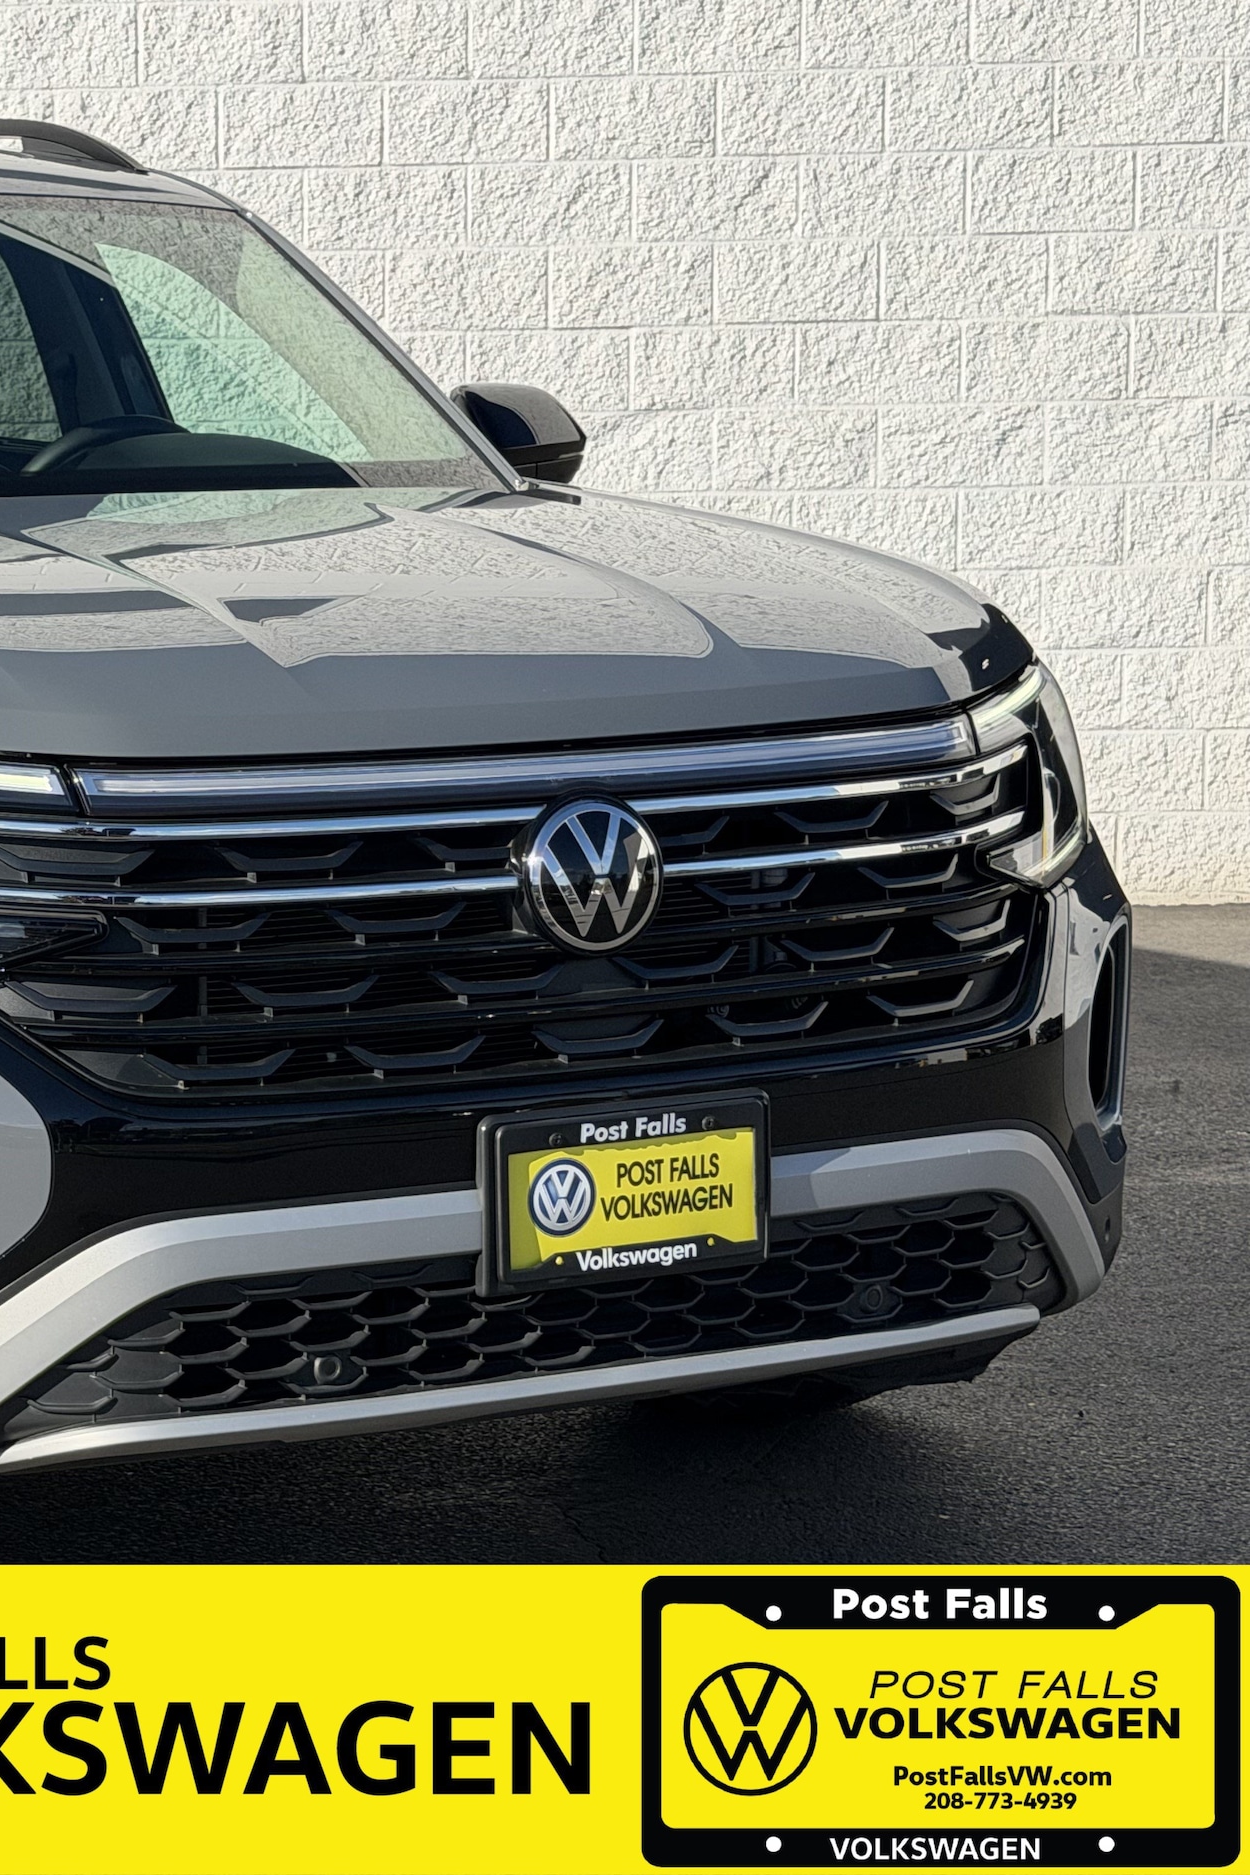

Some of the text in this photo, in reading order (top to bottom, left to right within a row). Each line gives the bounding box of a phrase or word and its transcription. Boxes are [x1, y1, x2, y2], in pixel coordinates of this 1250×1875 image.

[580, 1112, 687, 1143] Post Falls
[616, 1153, 720, 1188] POST FALLS
[600, 1183, 733, 1222] VOLKSWAGEN
[576, 1242, 698, 1271] Volkswagen
